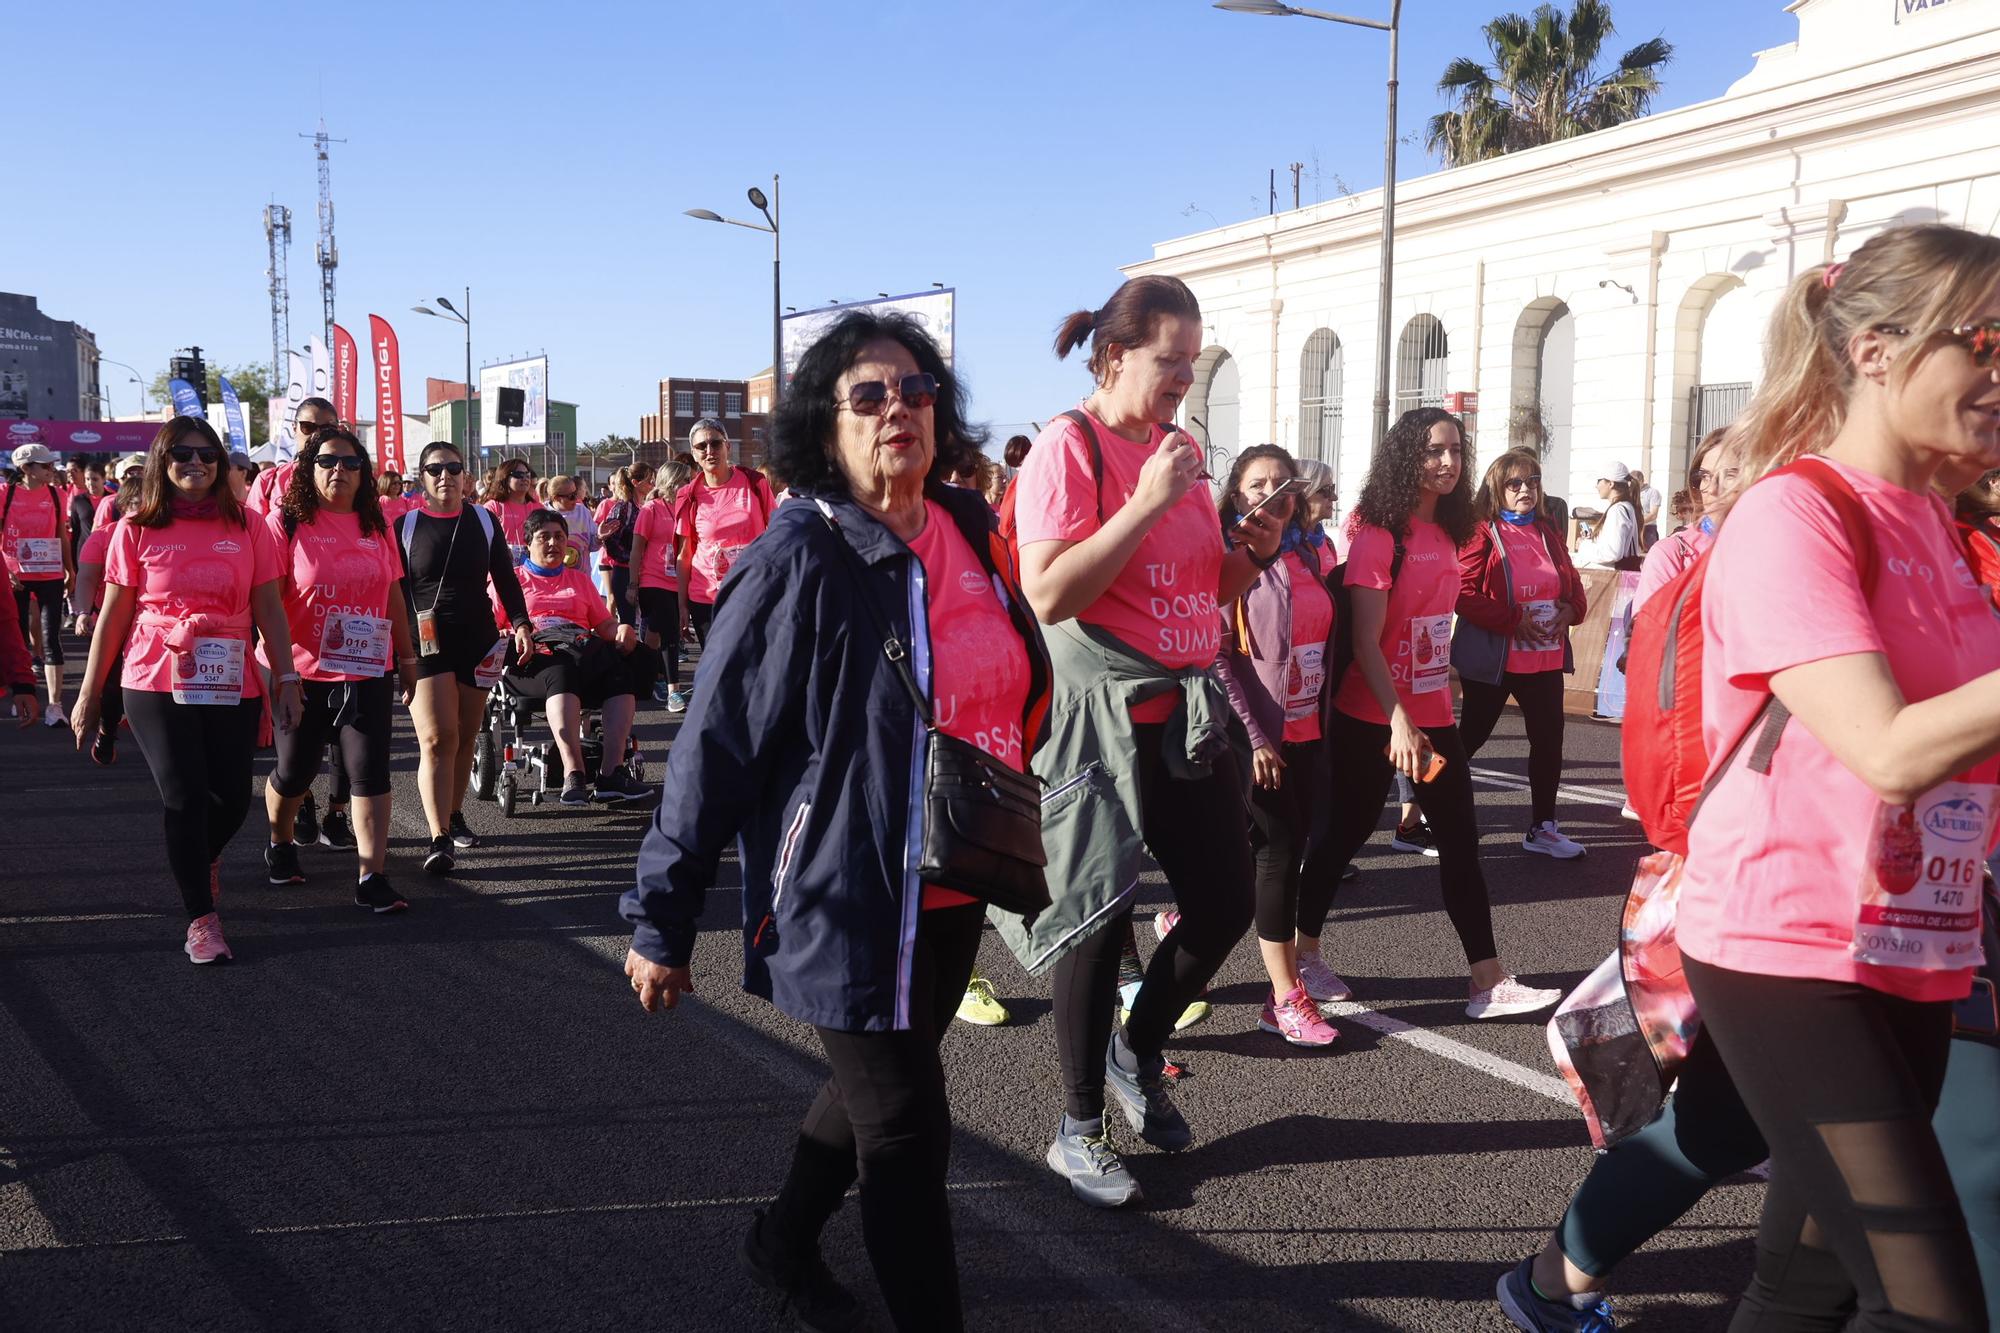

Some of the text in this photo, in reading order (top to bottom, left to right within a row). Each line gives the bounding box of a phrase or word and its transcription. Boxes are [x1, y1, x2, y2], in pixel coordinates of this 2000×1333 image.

[1146, 562, 1176, 588] TU
[313, 584, 336, 599] TU
[1520, 585, 1538, 598] TU
[345, 638, 368, 648] 016
[199, 663, 224, 674] 016
[1304, 673, 1320, 686] 016
[934, 694, 956, 727] U
[1927, 856, 1974, 884] 016
[1933, 890, 1964, 906] 1470
[1878, 911, 1925, 924] CARRERA
[1868, 935, 1923, 955] OYSHO
